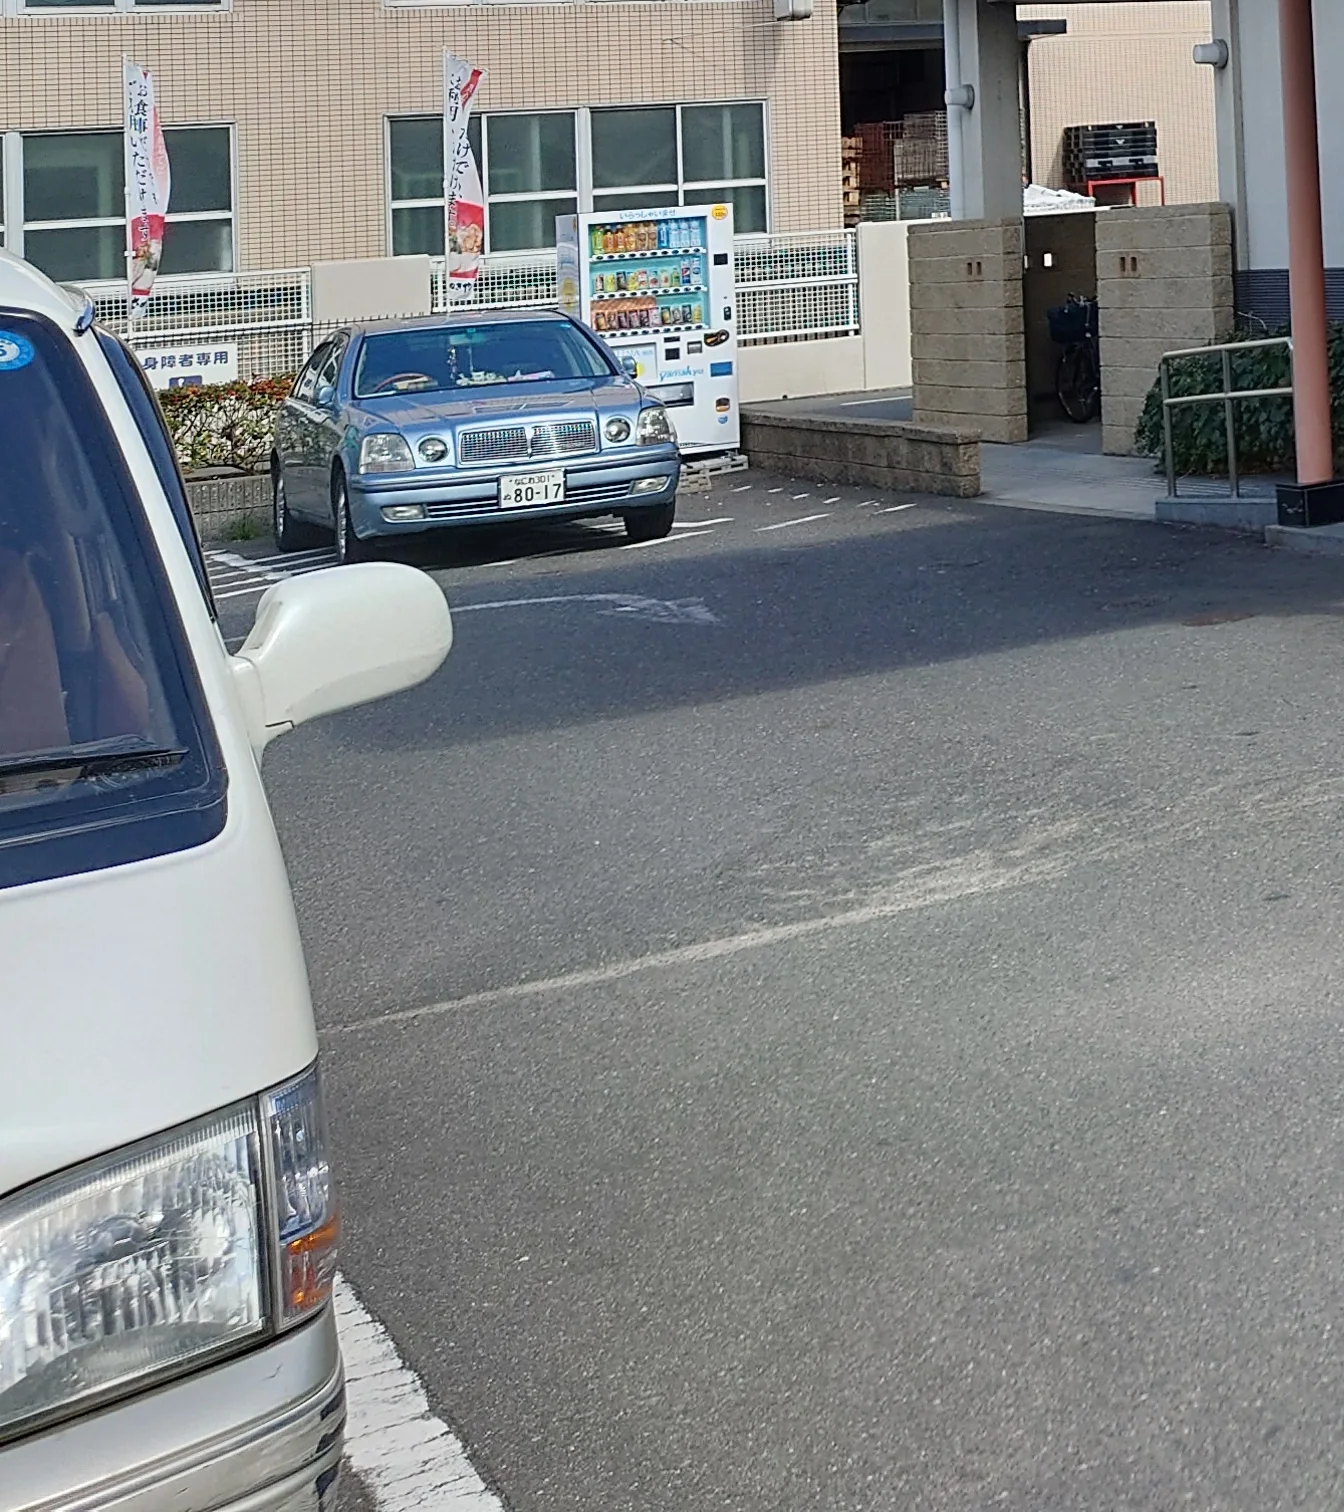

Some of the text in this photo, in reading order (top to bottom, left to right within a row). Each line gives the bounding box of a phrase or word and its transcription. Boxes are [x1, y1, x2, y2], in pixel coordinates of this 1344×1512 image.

[141, 351, 229, 370] 身障者専用
[514, 483, 562, 503] 80-17
